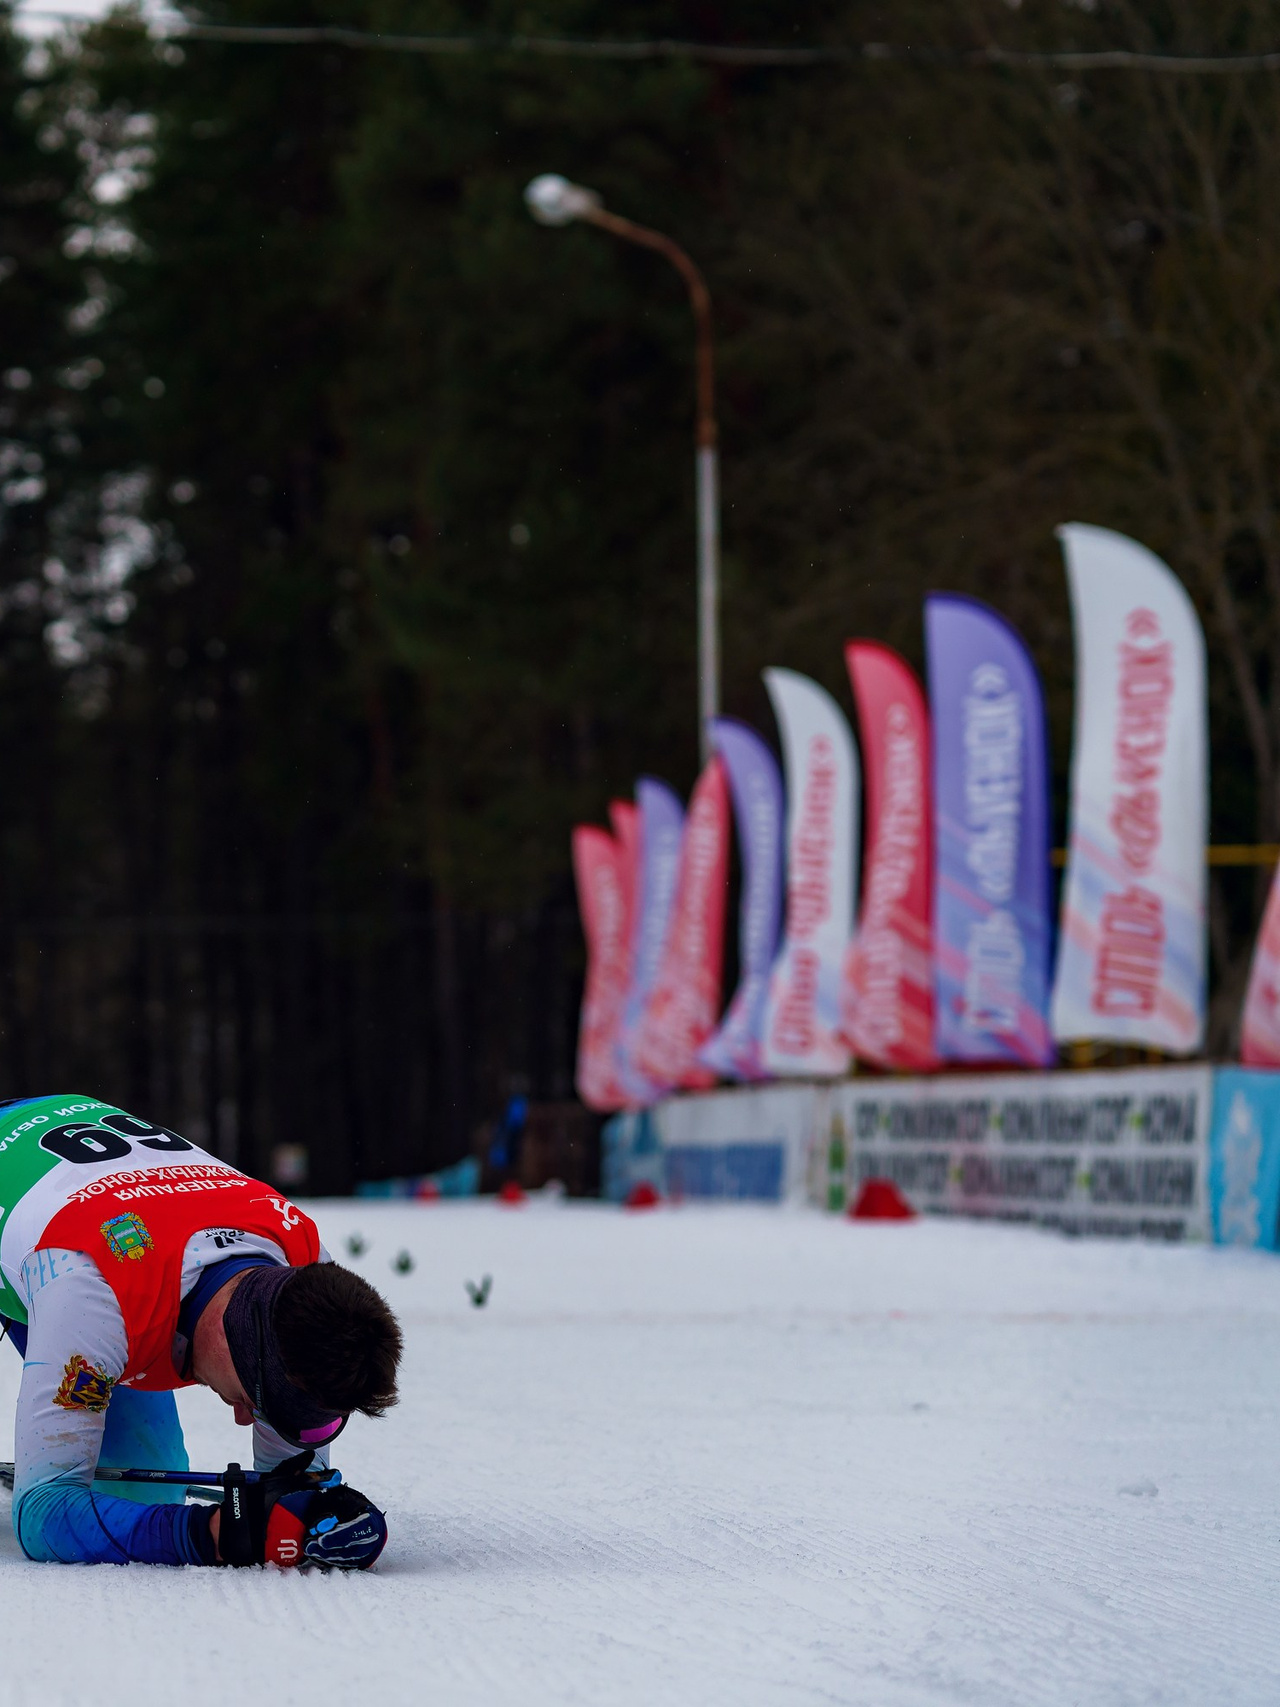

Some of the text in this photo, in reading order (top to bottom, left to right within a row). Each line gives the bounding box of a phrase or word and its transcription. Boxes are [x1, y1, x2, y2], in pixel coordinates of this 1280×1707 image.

[53, 1102, 116, 1118] СКОЙ
[39, 1114, 193, 1164] 69
[67, 1169, 152, 1203] ГОНОК
[113, 1178, 248, 1202] ФЕДЕРАЦИЯ
